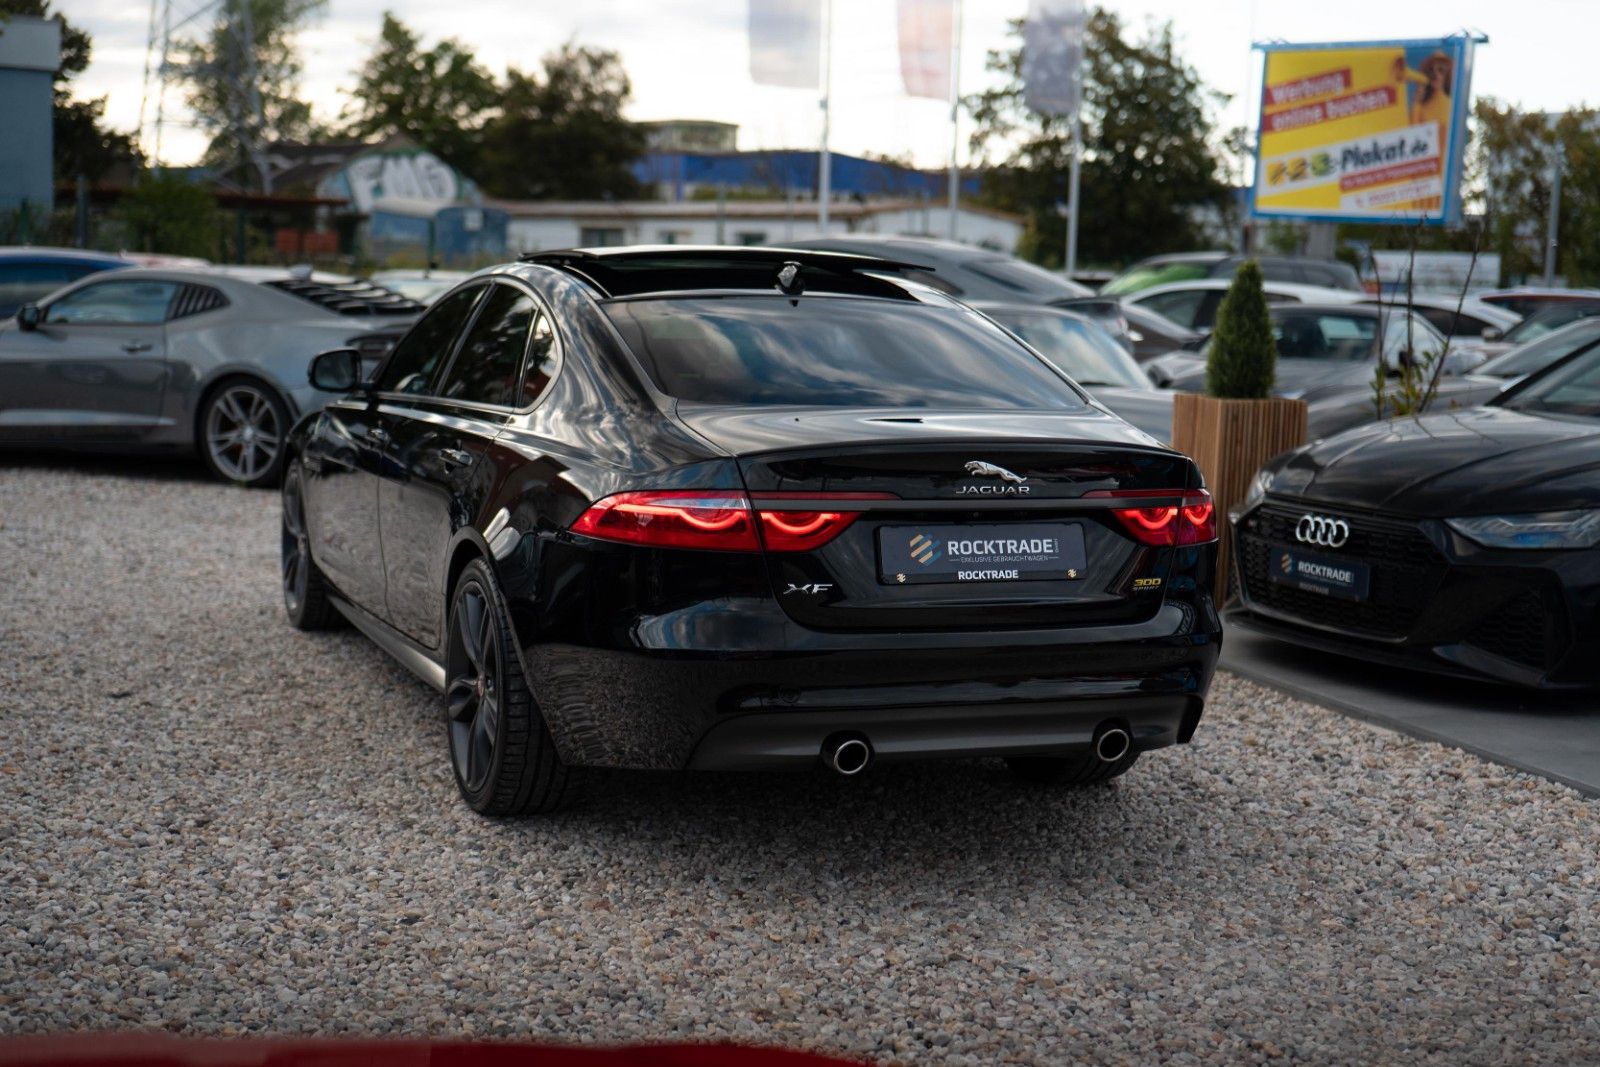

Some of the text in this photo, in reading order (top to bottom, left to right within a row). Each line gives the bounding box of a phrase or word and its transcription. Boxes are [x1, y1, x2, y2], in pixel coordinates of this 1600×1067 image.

[1272, 89, 1389, 131] online buchen
[955, 485, 1031, 495] JAGUAR
[947, 538, 1053, 555] ROCKTRADE
[957, 569, 1019, 580] ROCKTRADE
[1298, 561, 1352, 583] ROCKTRADE
[783, 583, 833, 594] XF
